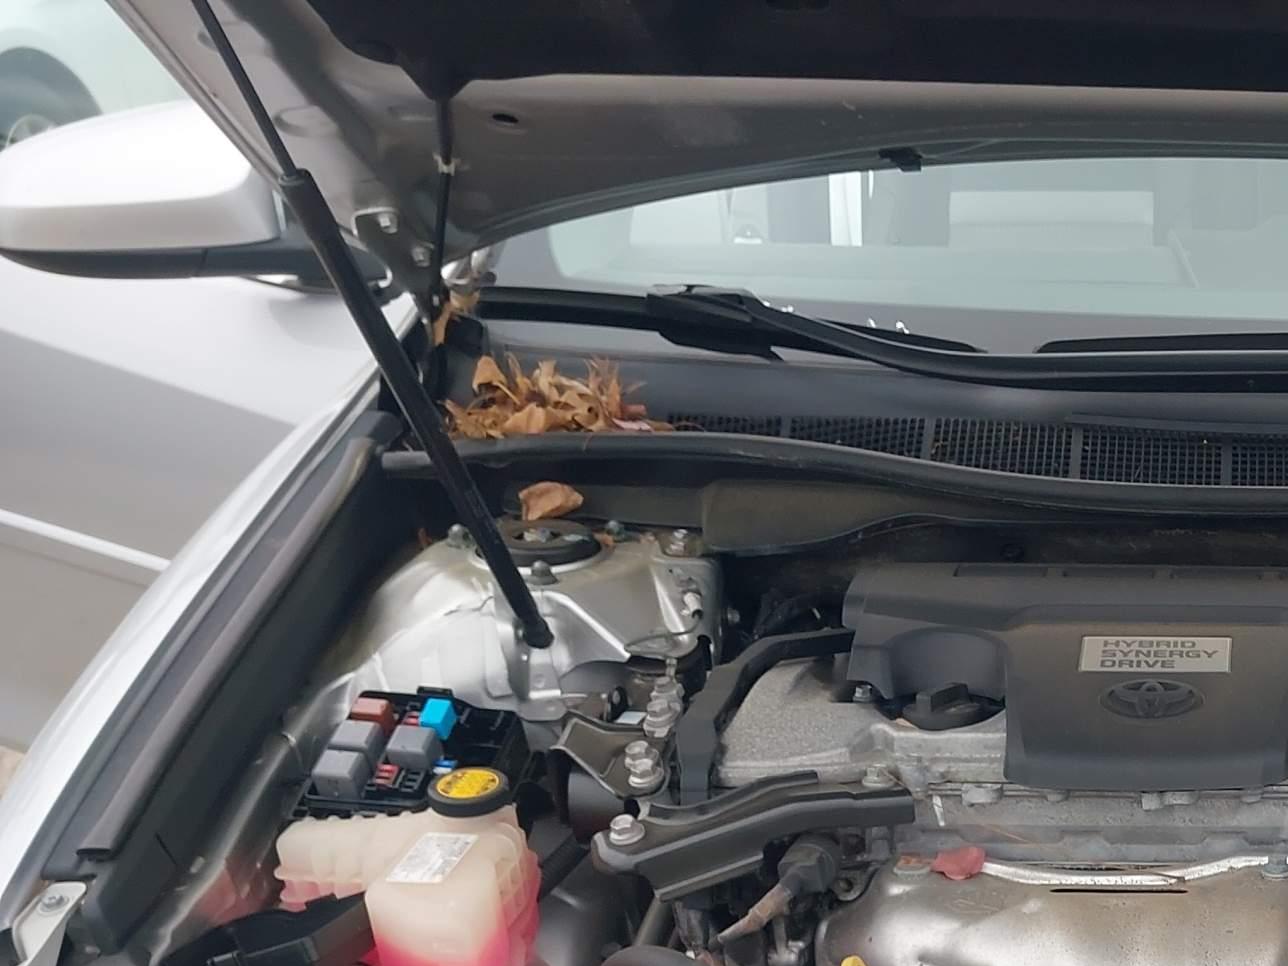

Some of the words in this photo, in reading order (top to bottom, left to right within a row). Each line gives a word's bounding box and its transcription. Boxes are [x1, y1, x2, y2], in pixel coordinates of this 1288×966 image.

[1103, 640, 1196, 648] HYBRID
[1101, 649, 1219, 658] SYNERGY
[1100, 659, 1176, 668] DRIVE
